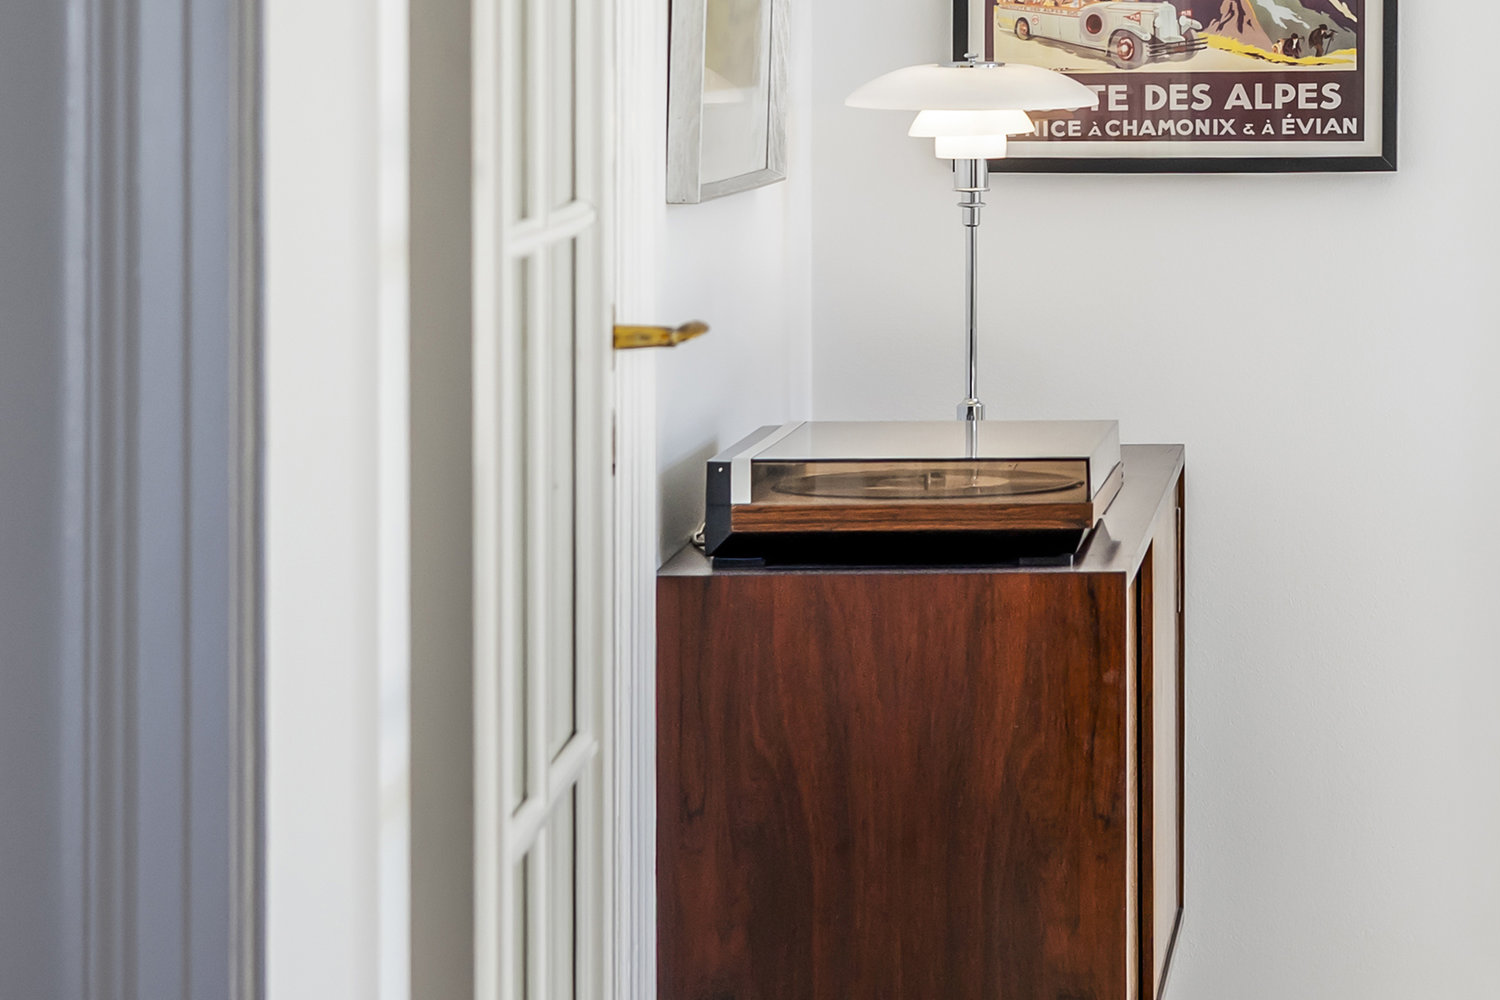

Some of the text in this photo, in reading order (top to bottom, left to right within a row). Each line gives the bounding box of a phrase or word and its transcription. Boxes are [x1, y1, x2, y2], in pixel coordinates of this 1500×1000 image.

[1144, 83, 1212, 112] DES
[1224, 83, 1343, 112] ALPES
[1104, 118, 1237, 137] CHAMONIX
[1243, 122, 1256, 135] &
[1281, 113, 1358, 136] ÉVIAN
